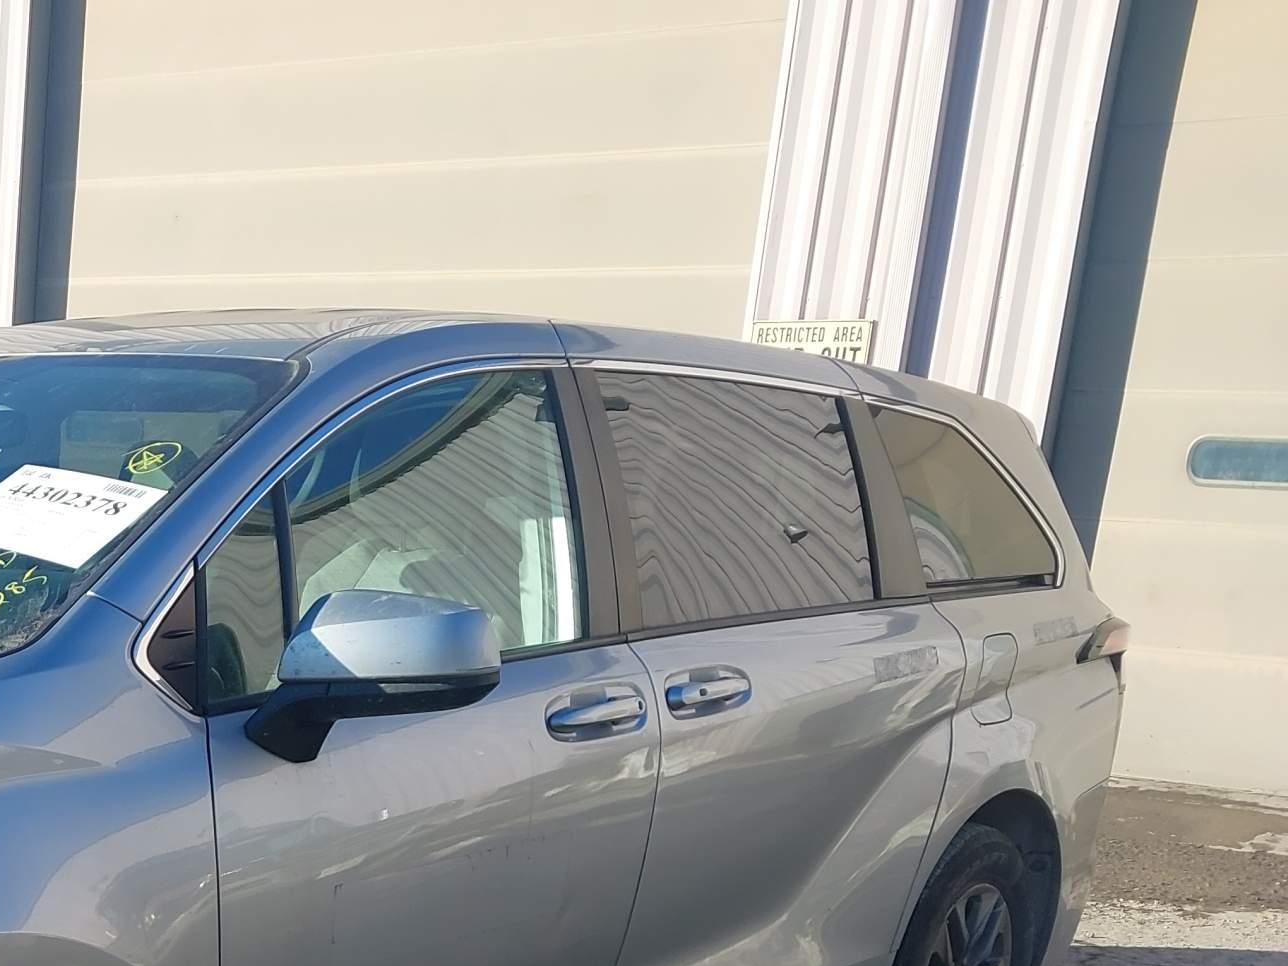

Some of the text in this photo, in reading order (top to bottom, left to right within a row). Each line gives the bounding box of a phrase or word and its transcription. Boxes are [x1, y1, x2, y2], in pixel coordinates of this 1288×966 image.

[756, 326, 863, 344] RESTRICTED AREA
[7, 482, 128, 516] 44302378
